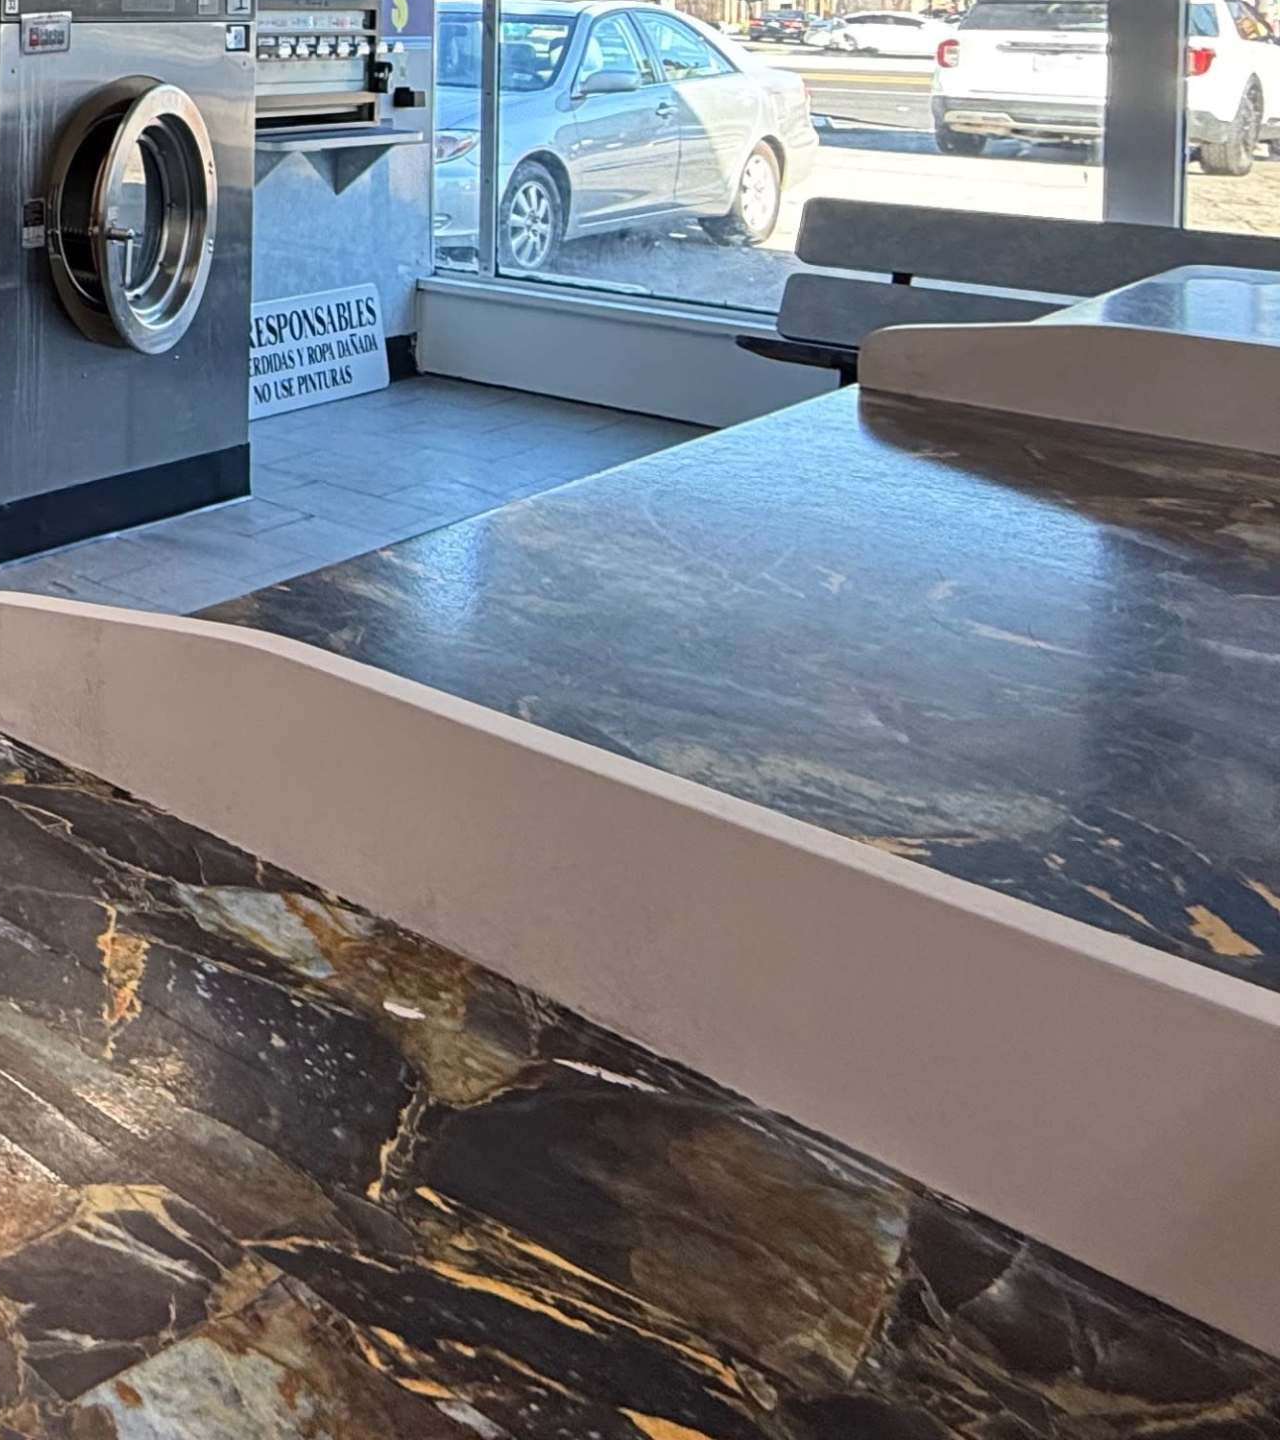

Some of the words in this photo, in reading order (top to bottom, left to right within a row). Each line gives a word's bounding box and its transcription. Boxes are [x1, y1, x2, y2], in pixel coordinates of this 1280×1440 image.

[297, 347, 306, 367] Y
[307, 341, 336, 365] ROPA
[336, 333, 379, 358] DAÑADA
[253, 382, 272, 404] NO
[275, 377, 296, 401] USE
[297, 365, 353, 395] PINTURAS
